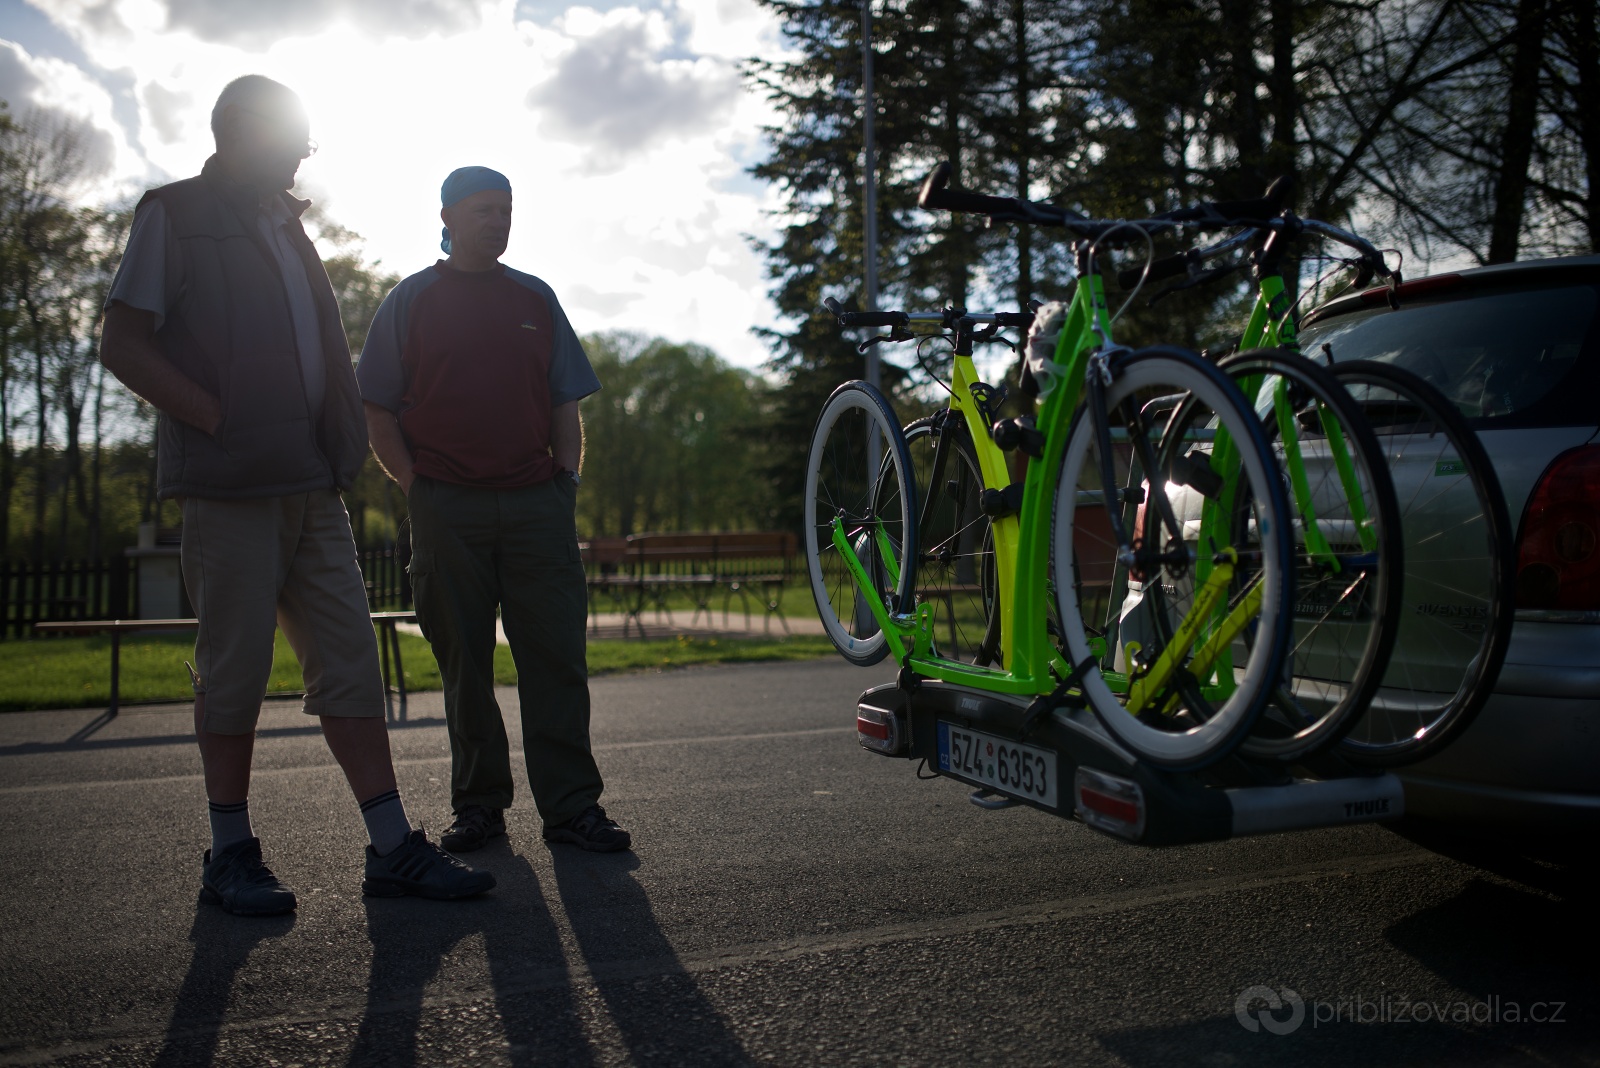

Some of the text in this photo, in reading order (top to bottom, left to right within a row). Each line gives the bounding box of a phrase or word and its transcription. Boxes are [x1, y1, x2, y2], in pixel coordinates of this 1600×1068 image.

[1416, 603, 1489, 618] AVENSIS
[961, 697, 981, 711] THULE
[940, 753, 949, 765] CZ
[951, 730, 1046, 797] 5Z4 6353
[1344, 799, 1390, 817] THULE
